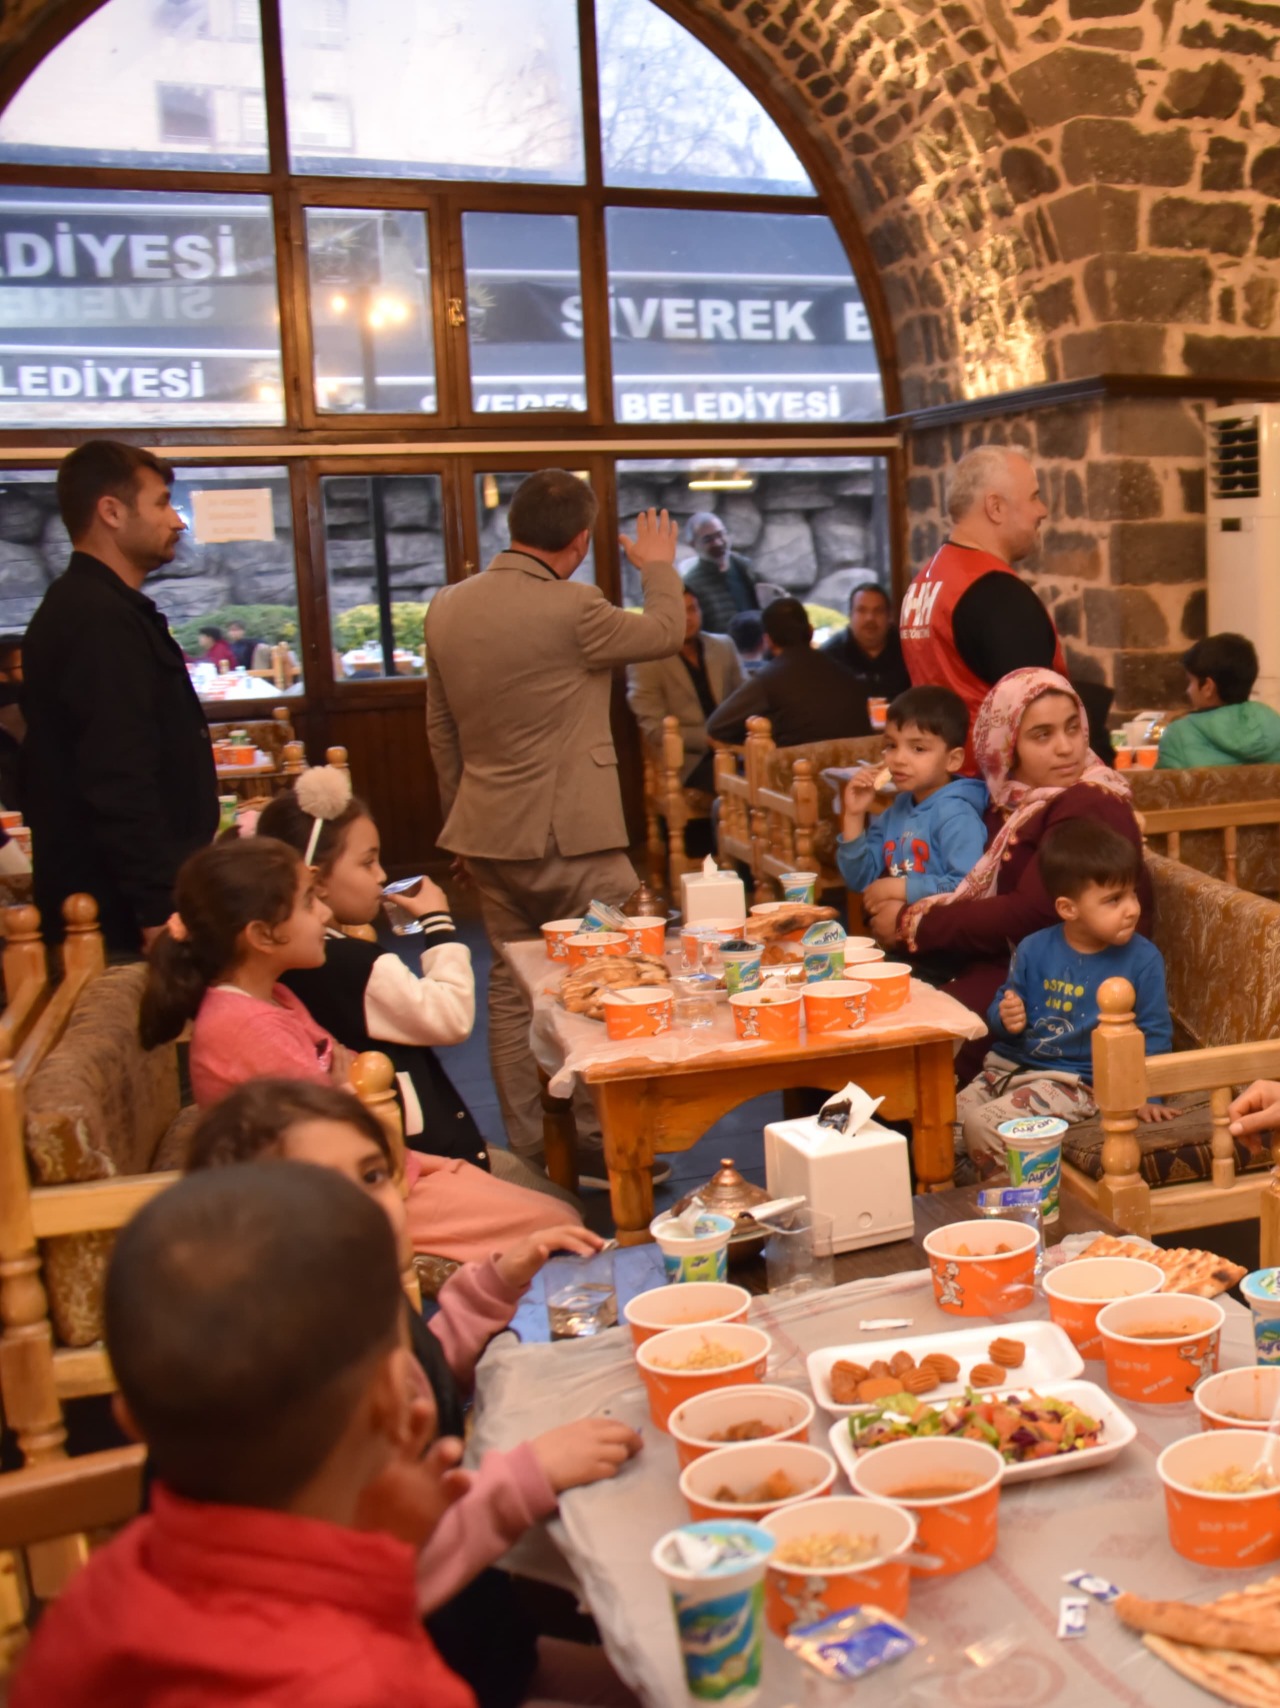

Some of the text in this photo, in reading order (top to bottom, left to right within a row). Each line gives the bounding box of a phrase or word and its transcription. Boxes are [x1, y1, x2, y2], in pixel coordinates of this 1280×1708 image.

[0, 222, 237, 279] DİYESİ
[0, 361, 204, 397] LEDİYESİ
[621, 386, 841, 420] BELEDİYESİ
